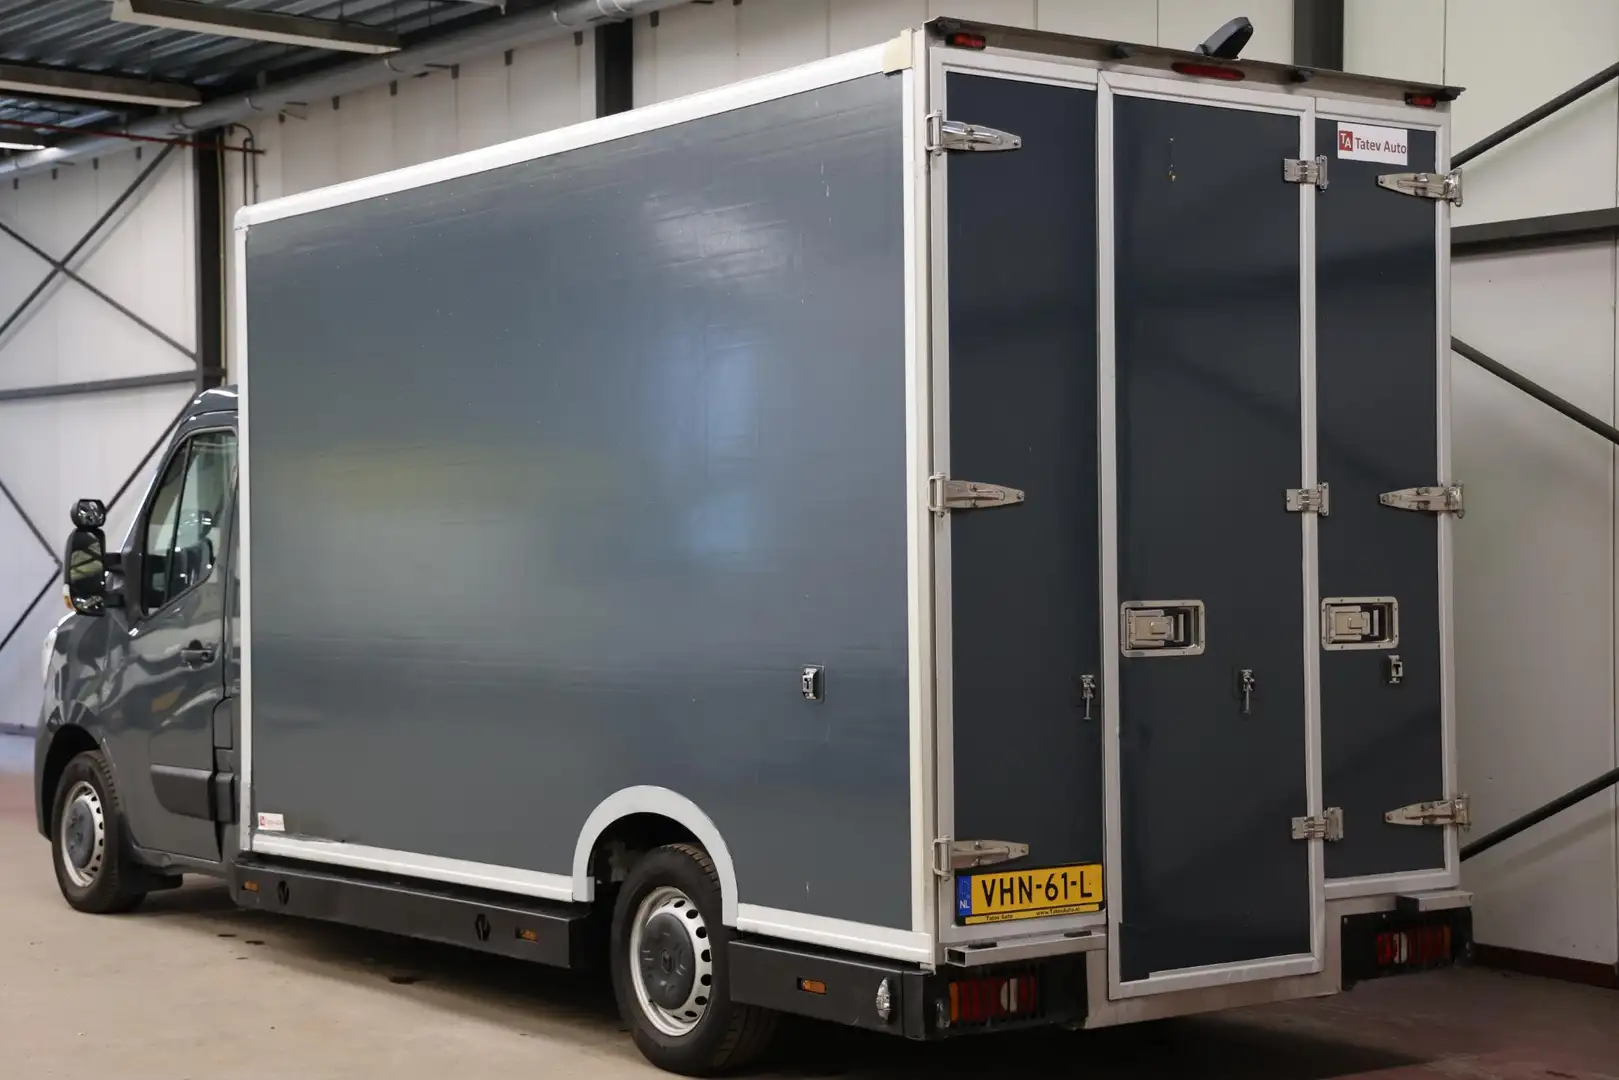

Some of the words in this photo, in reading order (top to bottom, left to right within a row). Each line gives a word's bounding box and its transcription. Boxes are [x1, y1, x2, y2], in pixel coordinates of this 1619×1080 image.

[1354, 136, 1382, 151] Tatev
[1384, 141, 1407, 154] Auto
[959, 899, 971, 909] NL
[981, 870, 1093, 908] VHN-61-L
